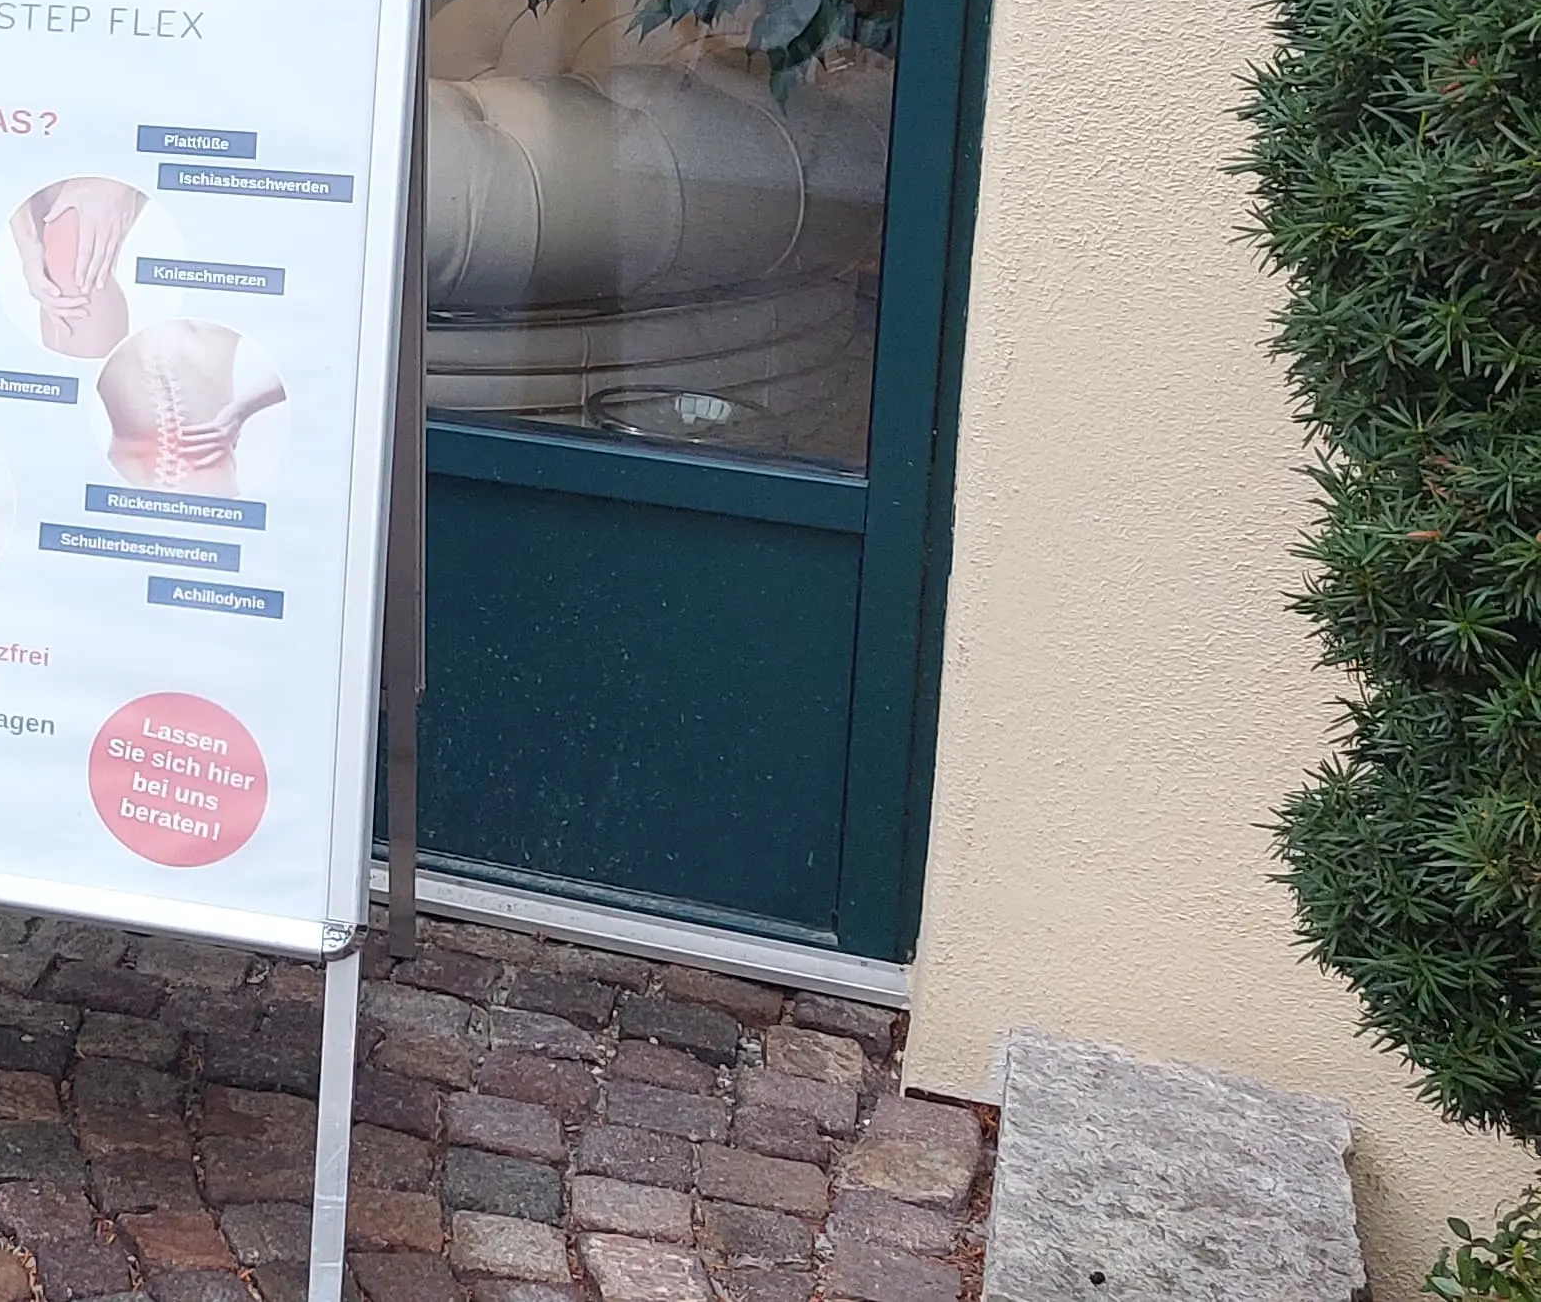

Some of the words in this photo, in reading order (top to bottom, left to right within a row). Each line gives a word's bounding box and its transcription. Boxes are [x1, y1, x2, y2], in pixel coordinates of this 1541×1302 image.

[108, 6, 205, 41] FLEX
[163, 134, 230, 151] Plattfüße
[178, 171, 330, 195] Ischiasbeschwerden
[152, 265, 267, 288] Knieschmerzen
[107, 493, 243, 522] Rückenschmerzen
[60, 532, 218, 563] Schulterbeschwerden
[172, 586, 265, 612] Achillodynie
[142, 717, 228, 756] Lassen
[107, 738, 146, 763] Sie
[150, 750, 201, 778] sich
[207, 761, 256, 791] hier
[132, 771, 170, 798] bei
[174, 785, 220, 812] uns
